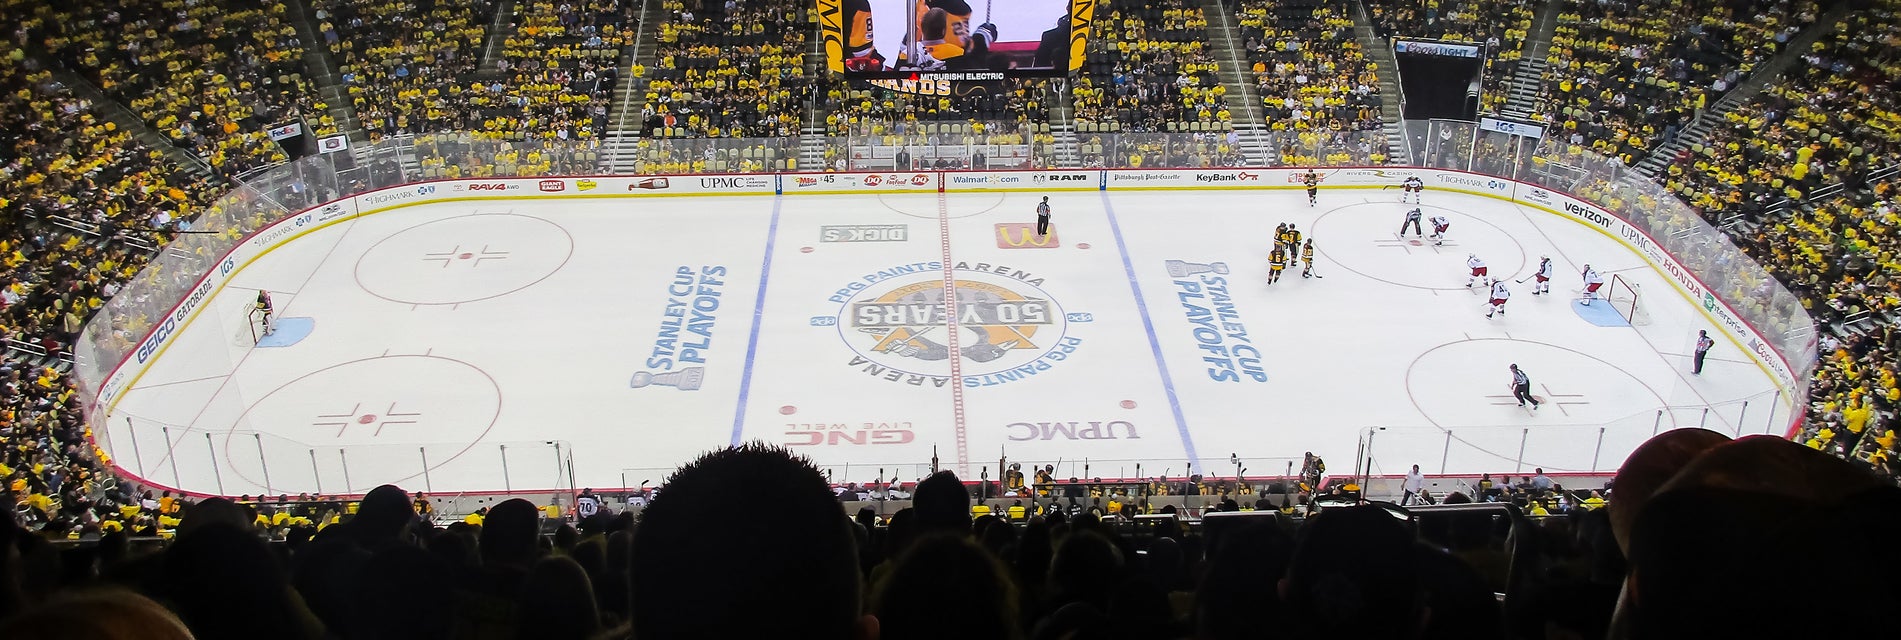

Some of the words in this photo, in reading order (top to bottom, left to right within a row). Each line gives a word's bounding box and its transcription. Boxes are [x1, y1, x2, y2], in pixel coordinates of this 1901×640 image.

[820, 0, 843, 62] MC
[1405, 42, 1440, 55] Coors
[1441, 47, 1469, 57] LIGHT
[920, 72, 965, 81] MITSUBISHI
[966, 72, 1004, 80] ELECTRIC
[272, 127, 295, 138] FedEx
[1496, 121, 1515, 132] IGS
[468, 183, 507, 191] RAV4
[700, 177, 744, 188] UPMC
[1196, 173, 1236, 182] KeyBank
[1438, 174, 1484, 187] HIGHMARK
[367, 191, 414, 205] HIGHMARK
[1563, 201, 1610, 228] verizon
[255, 223, 294, 247] HIGHMARK
[1621, 224, 1651, 252] UPMC
[220, 257, 234, 277] IGS
[1663, 258, 1702, 299] HONDA
[829, 281, 867, 304] PPG
[863, 261, 943, 283] PAINTS
[955, 261, 1045, 287] ARENA
[176, 279, 213, 322] GATORADE
[646, 297, 687, 371] STANLEY
[669, 265, 696, 297] CUP
[678, 265, 727, 364] PLAYOFFS
[859, 303, 984, 325] YEARS
[996, 303, 1045, 323] 50
[1704, 297, 1747, 338] enterprise
[138, 316, 175, 364] GEICO
[1173, 280, 1240, 383] PLAYOFFS
[1200, 274, 1251, 344] STANLEY
[1232, 344, 1268, 383] CUP
[1045, 336, 1083, 362] PPG
[848, 355, 950, 388] ARENA
[963, 359, 1052, 388] PAINTS
[864, 422, 913, 430] LIVE
[1005, 420, 1142, 441] UPMC
[783, 430, 915, 446] GNC
[580, 502, 592, 512] 70
